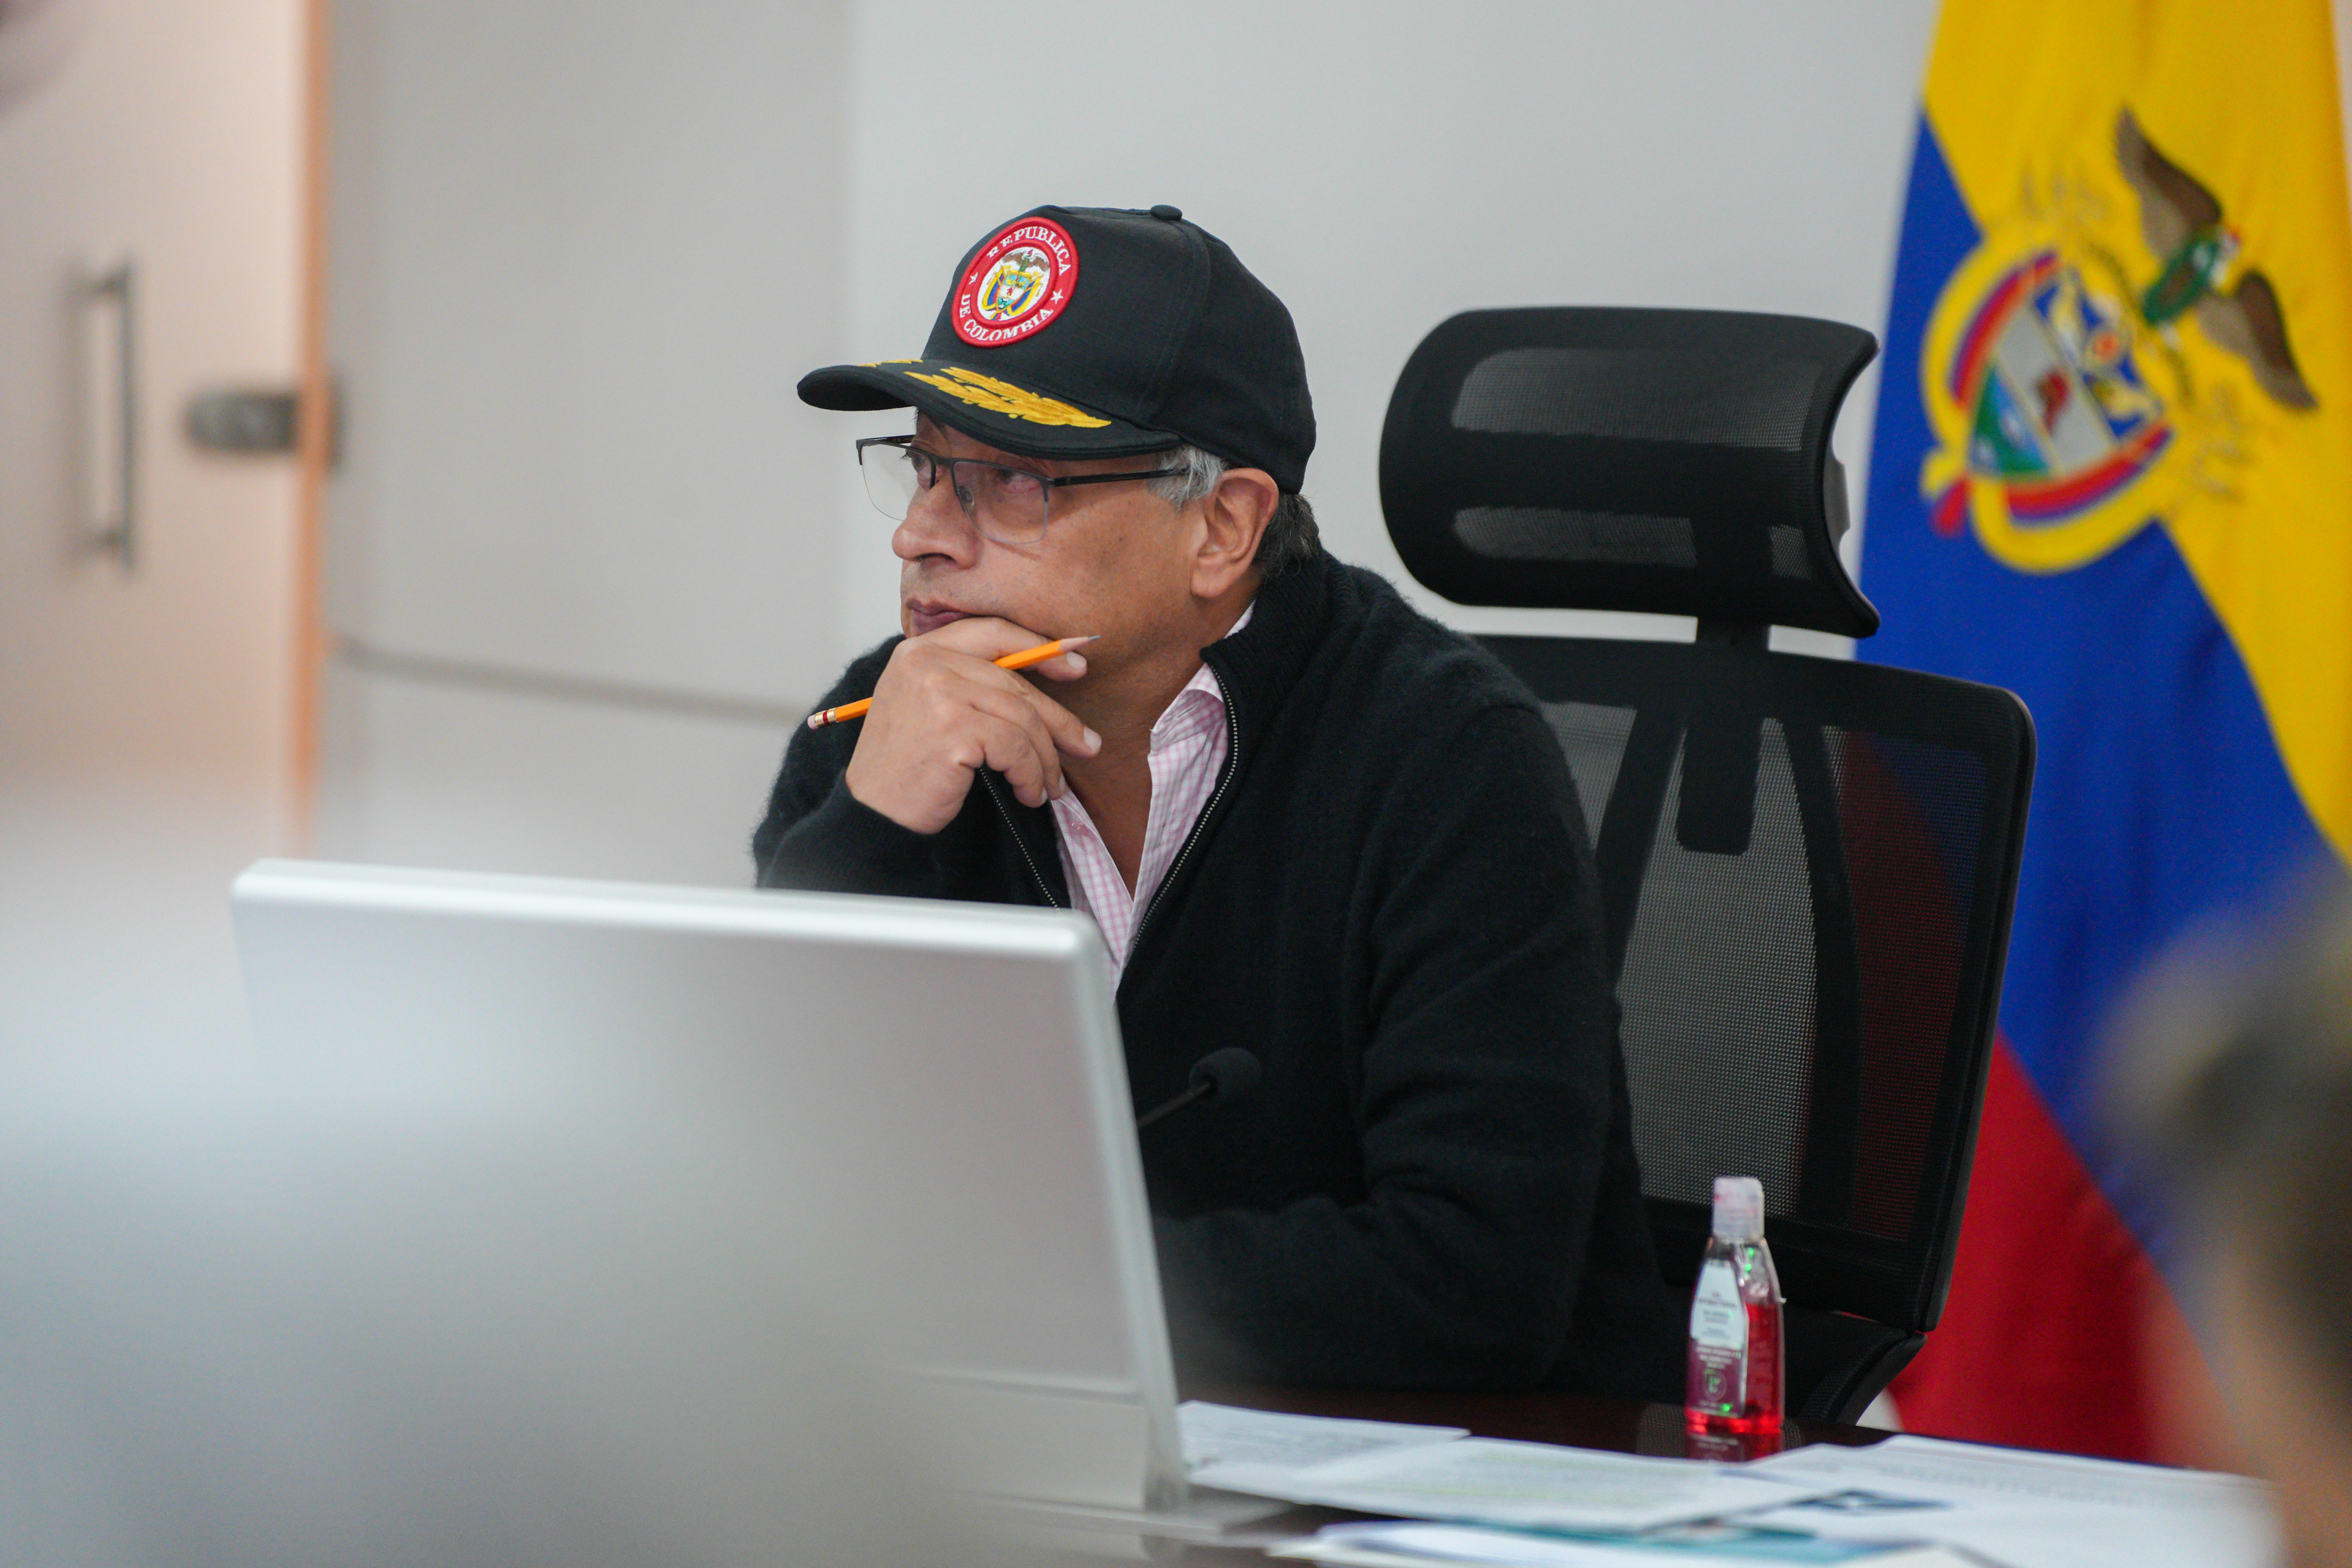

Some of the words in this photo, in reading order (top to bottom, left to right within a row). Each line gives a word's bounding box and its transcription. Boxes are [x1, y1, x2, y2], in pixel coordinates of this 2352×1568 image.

[986, 226, 1071, 276] REPUBLICA
[960, 294, 971, 318] DE
[963, 309, 1054, 341] COLOMBIA
